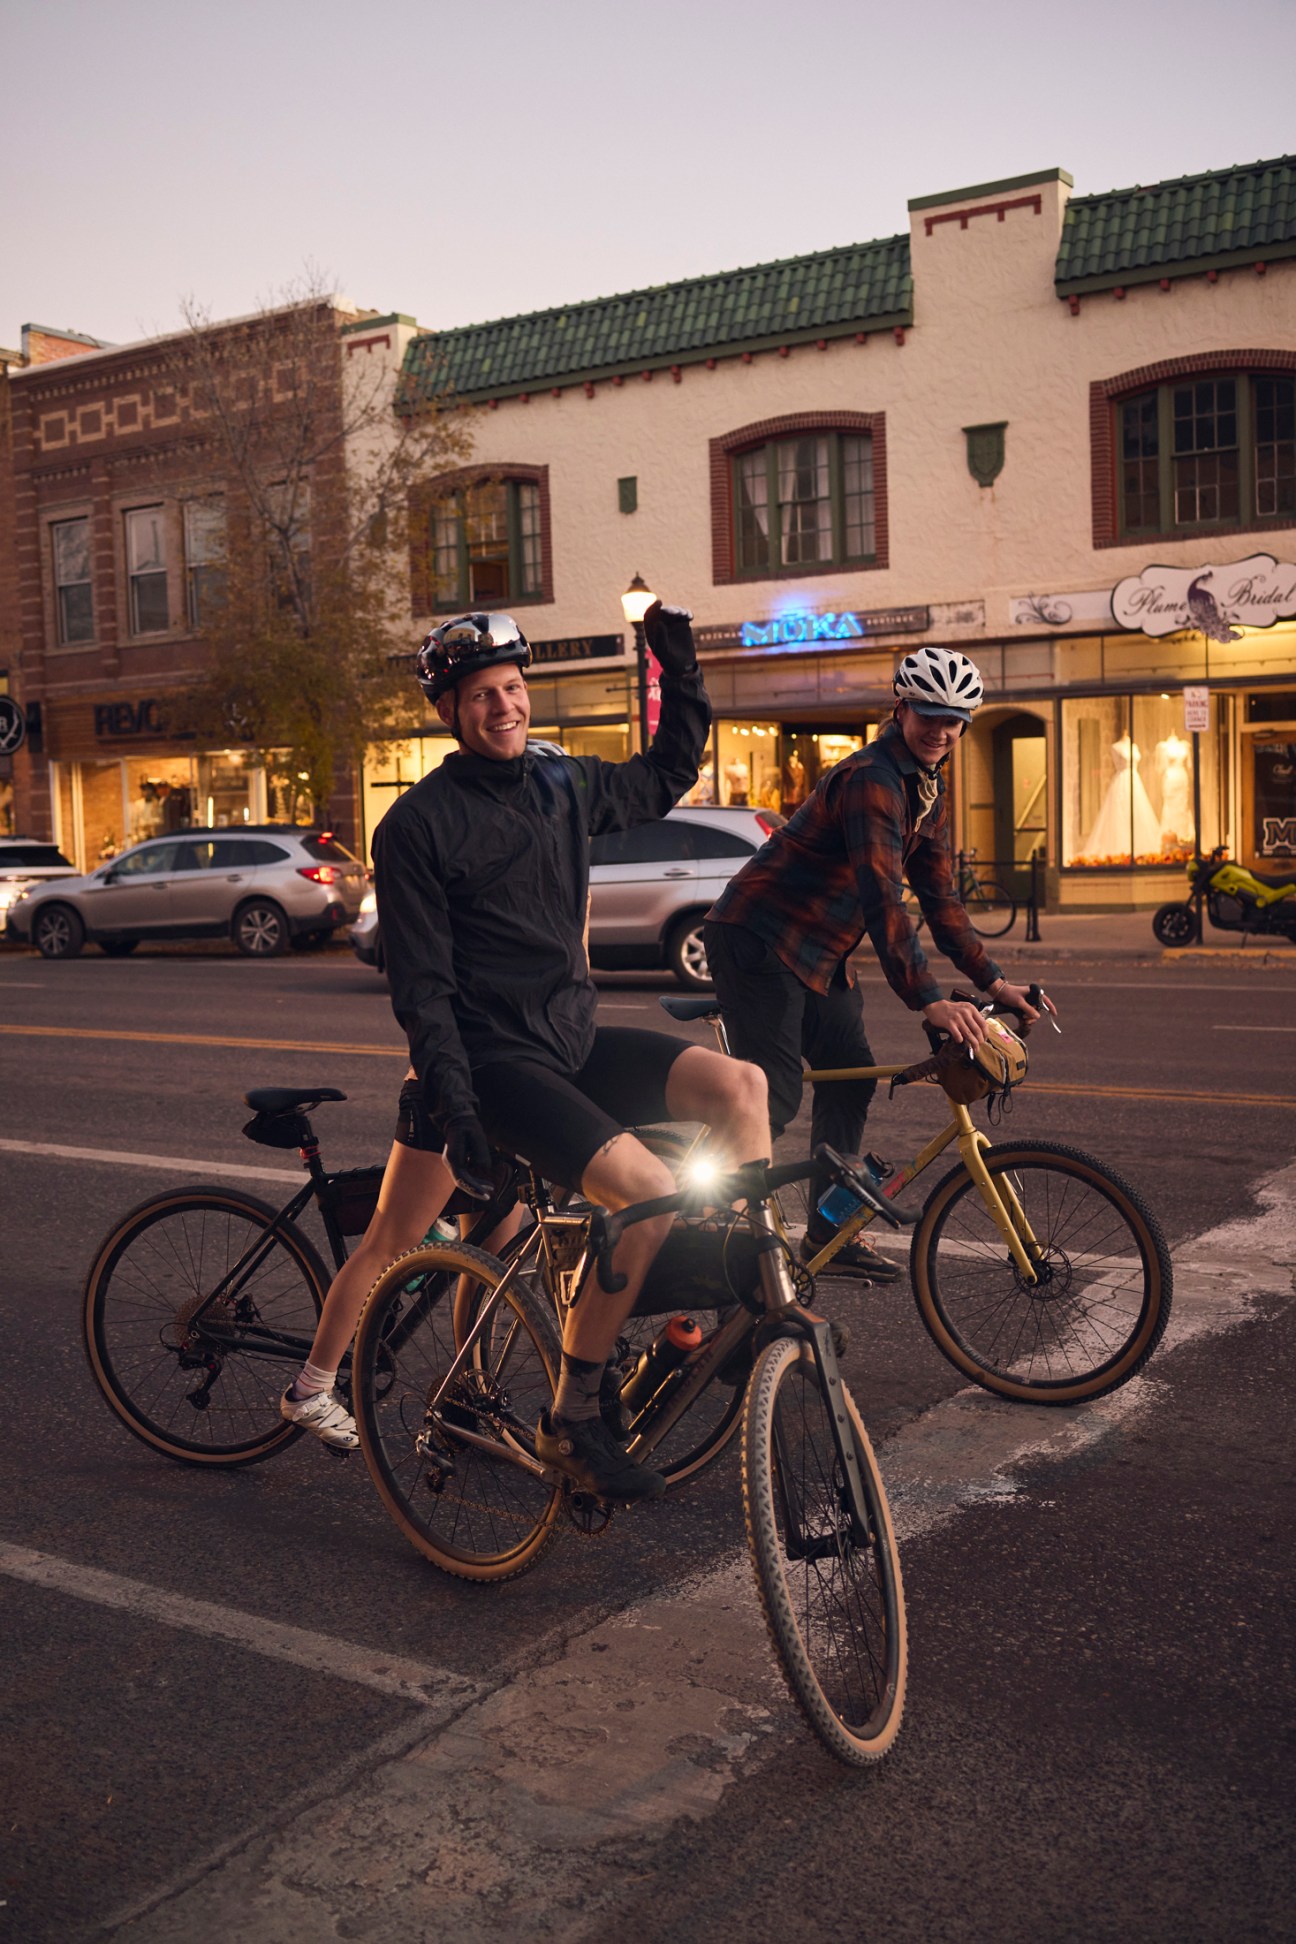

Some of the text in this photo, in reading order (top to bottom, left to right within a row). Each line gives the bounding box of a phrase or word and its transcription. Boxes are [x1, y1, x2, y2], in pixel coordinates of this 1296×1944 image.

[1123, 574, 1296, 617] Plume Bridal
[866, 614, 914, 626] BOUTIQUE
[535, 640, 593, 660] LLERY
